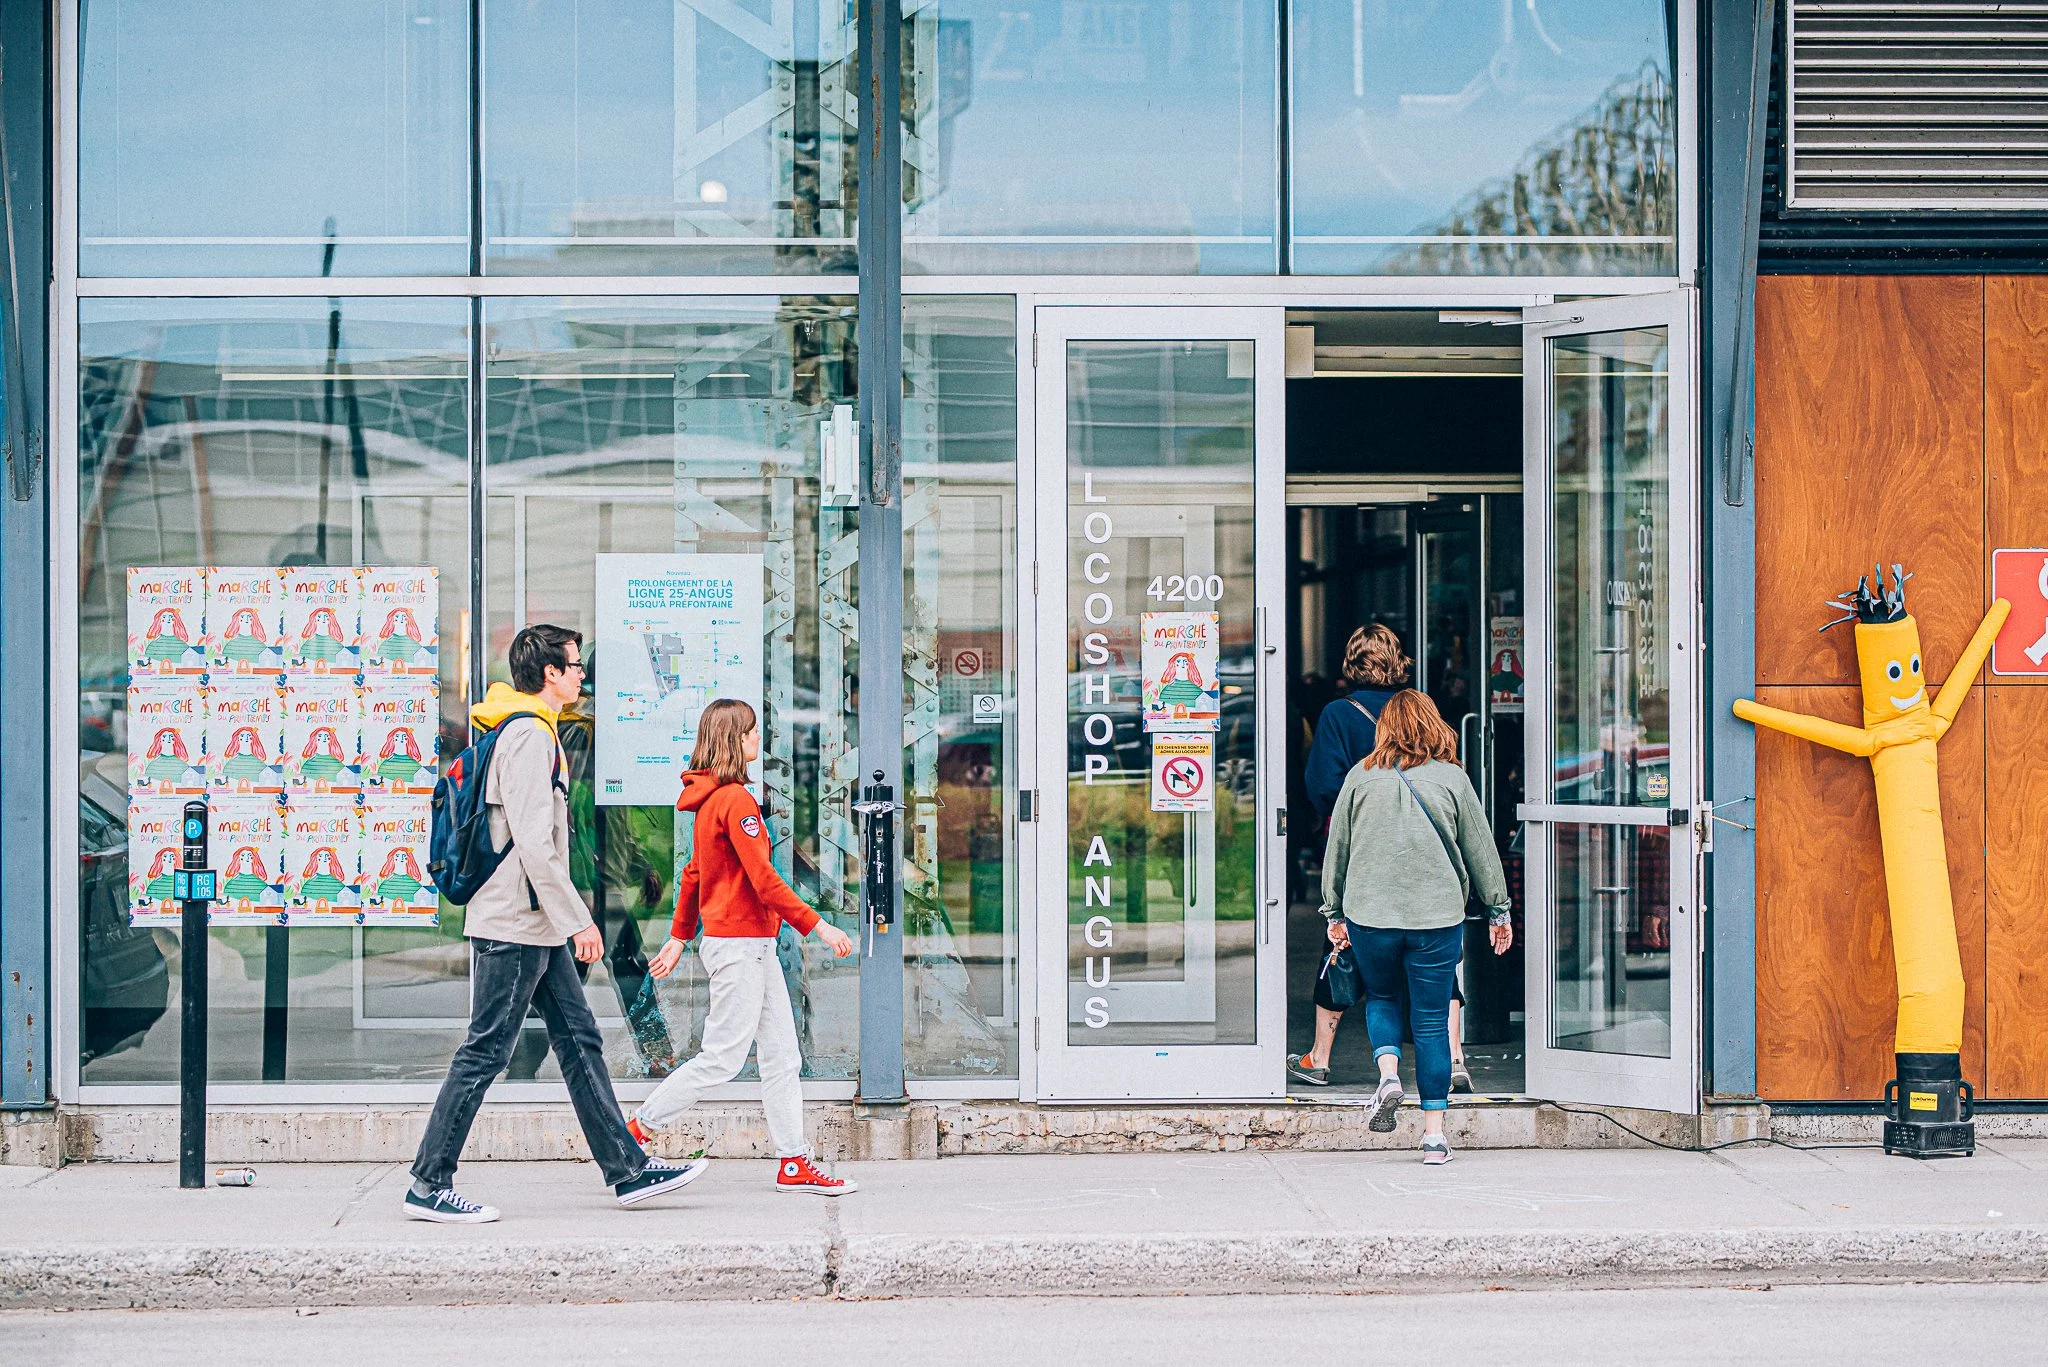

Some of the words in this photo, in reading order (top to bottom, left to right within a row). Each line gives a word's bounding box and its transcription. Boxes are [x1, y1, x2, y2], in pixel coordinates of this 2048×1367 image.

[628, 579, 704, 587] PROLONGEMENT
[707, 579, 719, 587] DE
[721, 579, 733, 587] LA
[1146, 574, 1224, 602] 4200
[628, 589, 665, 598] LIGNE
[669, 589, 733, 598] 25-ANGUS
[628, 598, 666, 609] JUSQU'À
[669, 598, 733, 609] PRÉFONTAINE
[1083, 472, 1114, 786] LOCOSHOP
[177, 873, 186, 885] RG
[196, 874, 210, 886] RG
[196, 886, 211, 897] 105
[1083, 835, 1113, 1029] ANGUS
